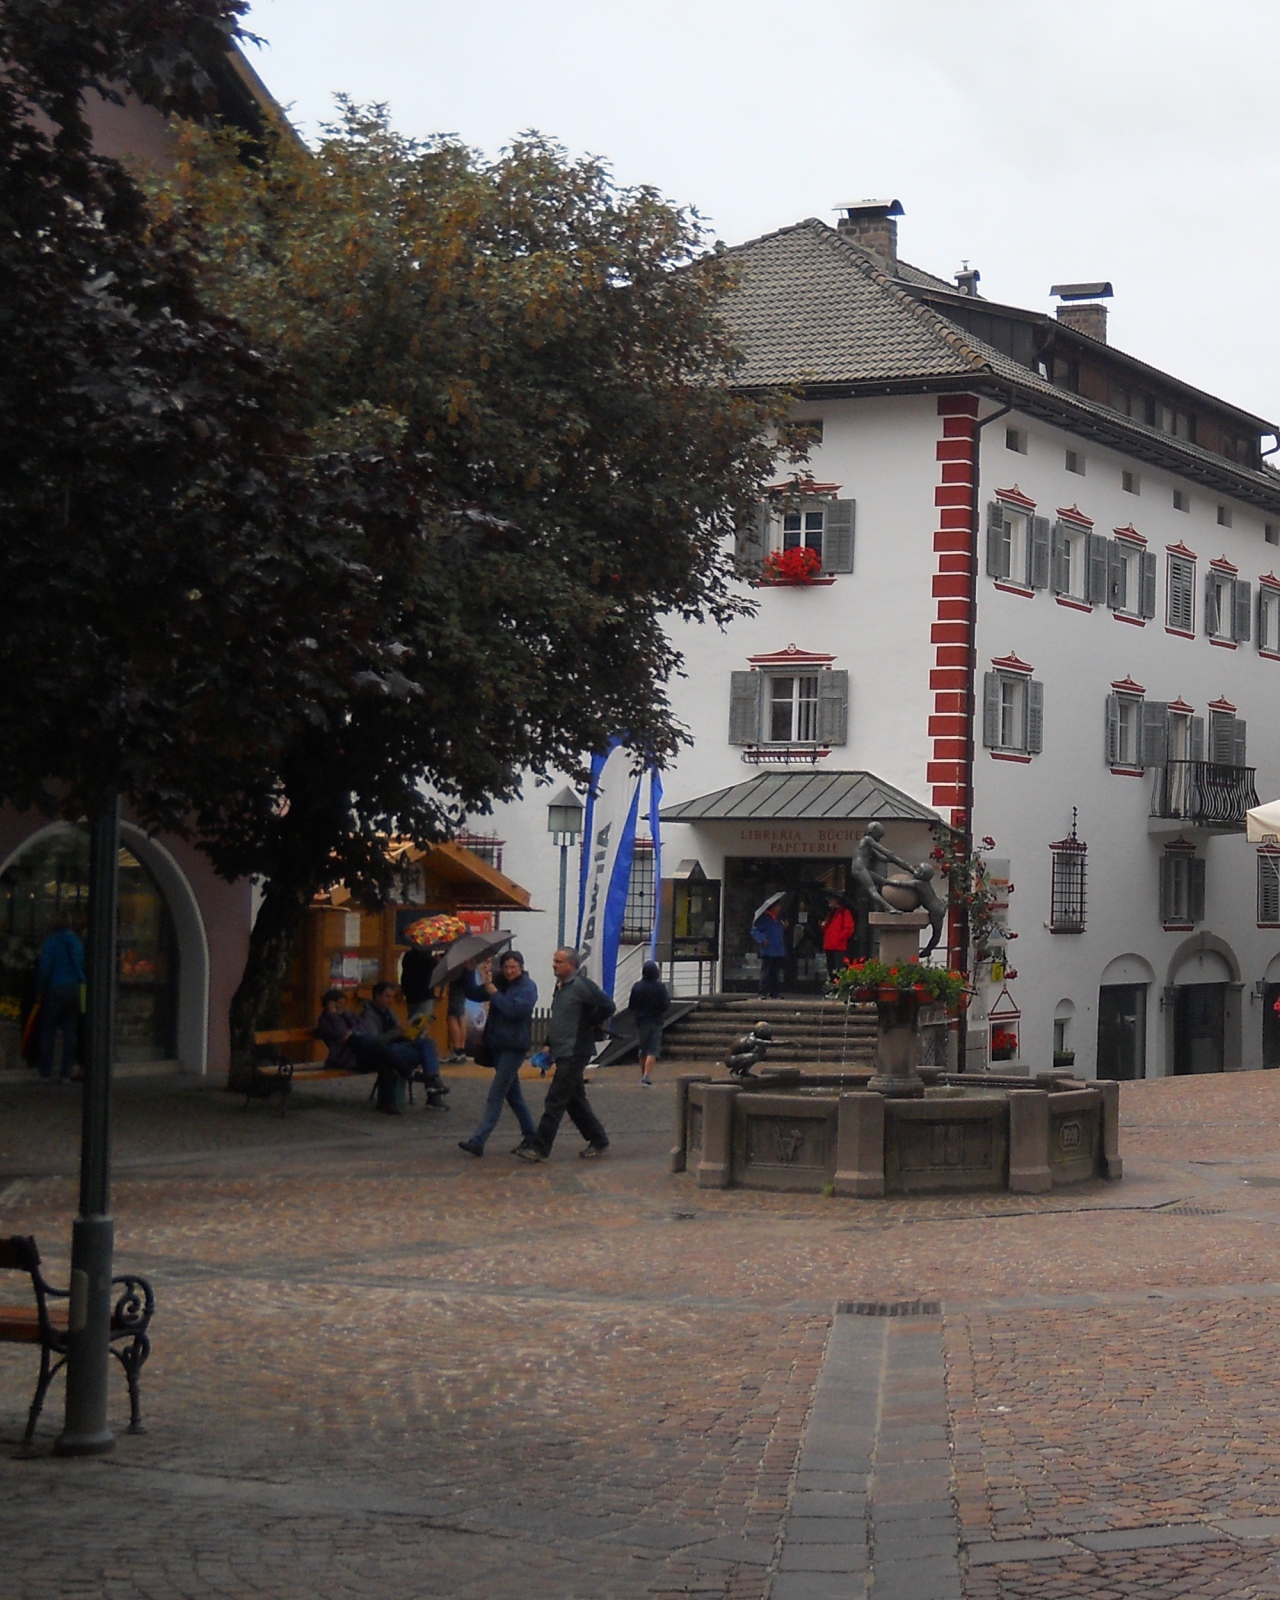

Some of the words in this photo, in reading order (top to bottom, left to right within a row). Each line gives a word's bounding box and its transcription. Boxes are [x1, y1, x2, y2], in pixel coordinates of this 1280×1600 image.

[740, 829, 802, 841] LIBRERIA
[818, 828, 868, 841] BÜCHE
[770, 842, 839, 853] PAPETERIE
